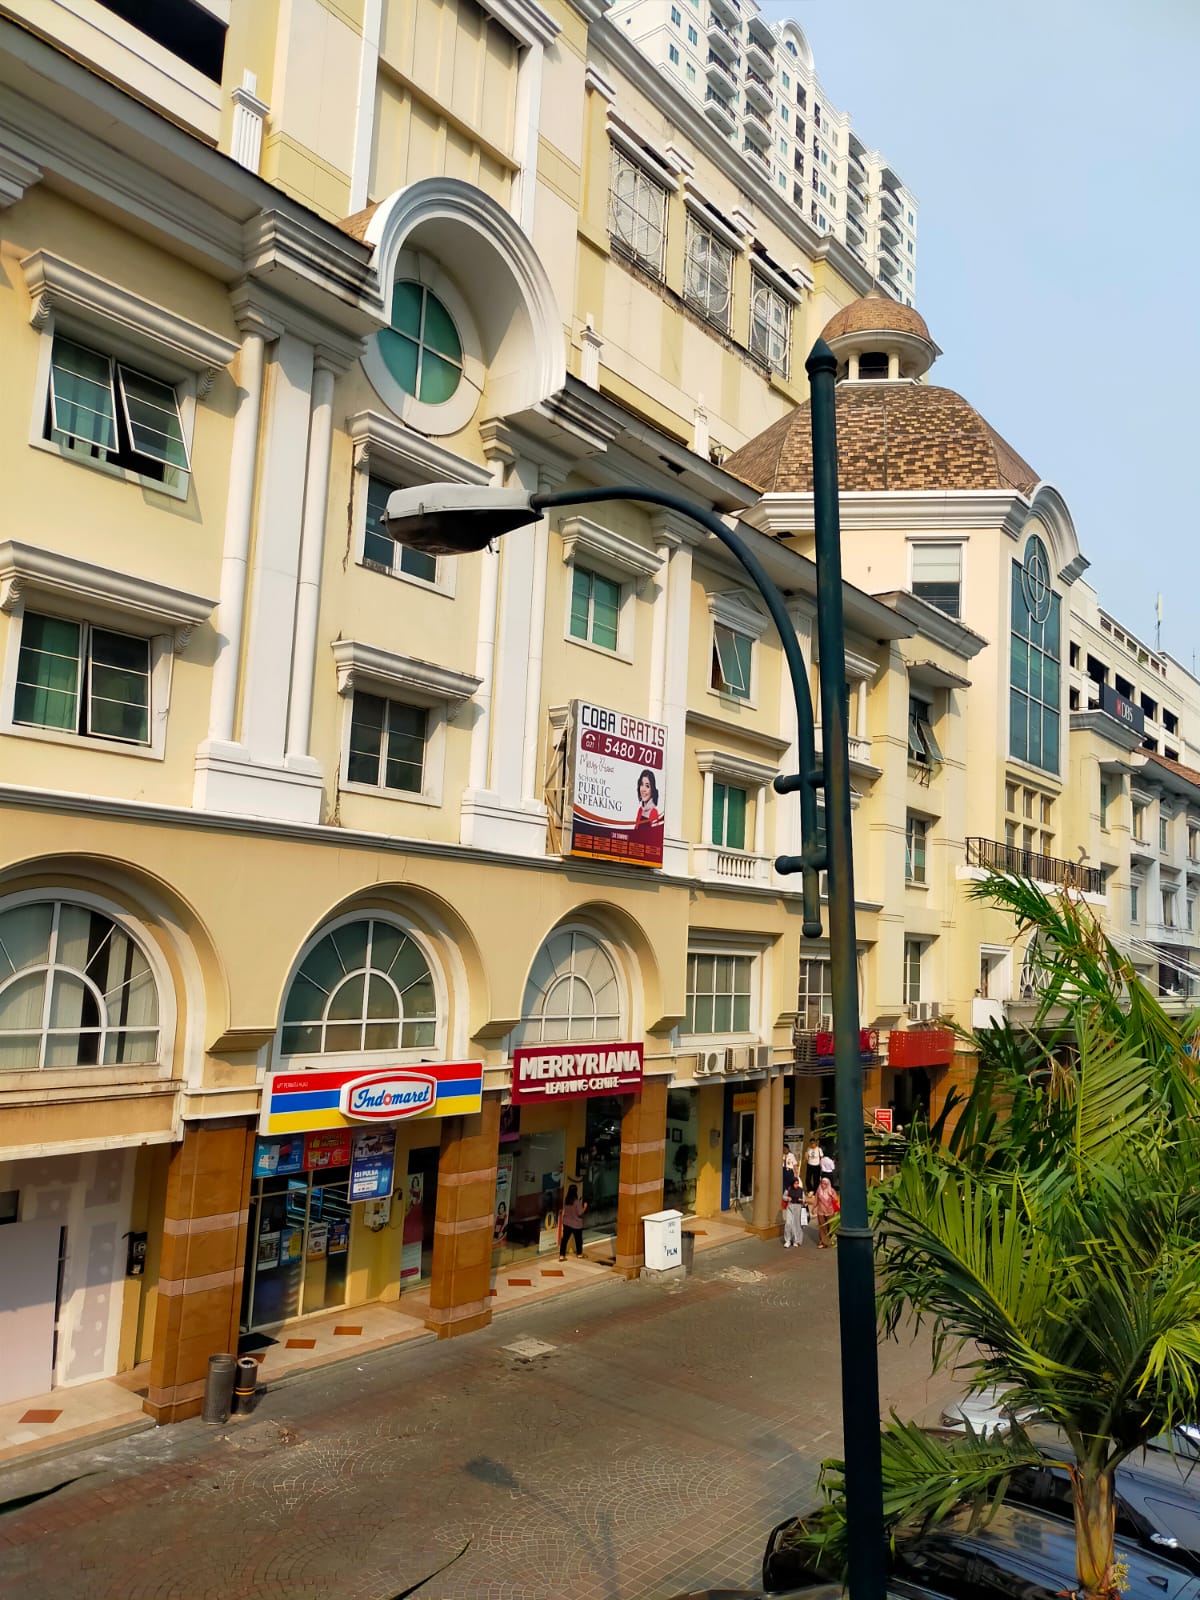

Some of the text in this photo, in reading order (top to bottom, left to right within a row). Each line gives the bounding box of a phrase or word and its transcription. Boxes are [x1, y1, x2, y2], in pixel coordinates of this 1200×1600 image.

[1121, 702, 1133, 723] DBS
[582, 705, 665, 748] COBA GRATIS
[604, 738, 657, 766] 5480 701
[578, 781, 611, 798] PUBLIC
[578, 793, 622, 811] SPEAKING
[519, 1050, 640, 1080] MERRYRIANA
[545, 1076, 620, 1095] LEARNING CENTRE
[353, 1085, 430, 1109] Indomaret
